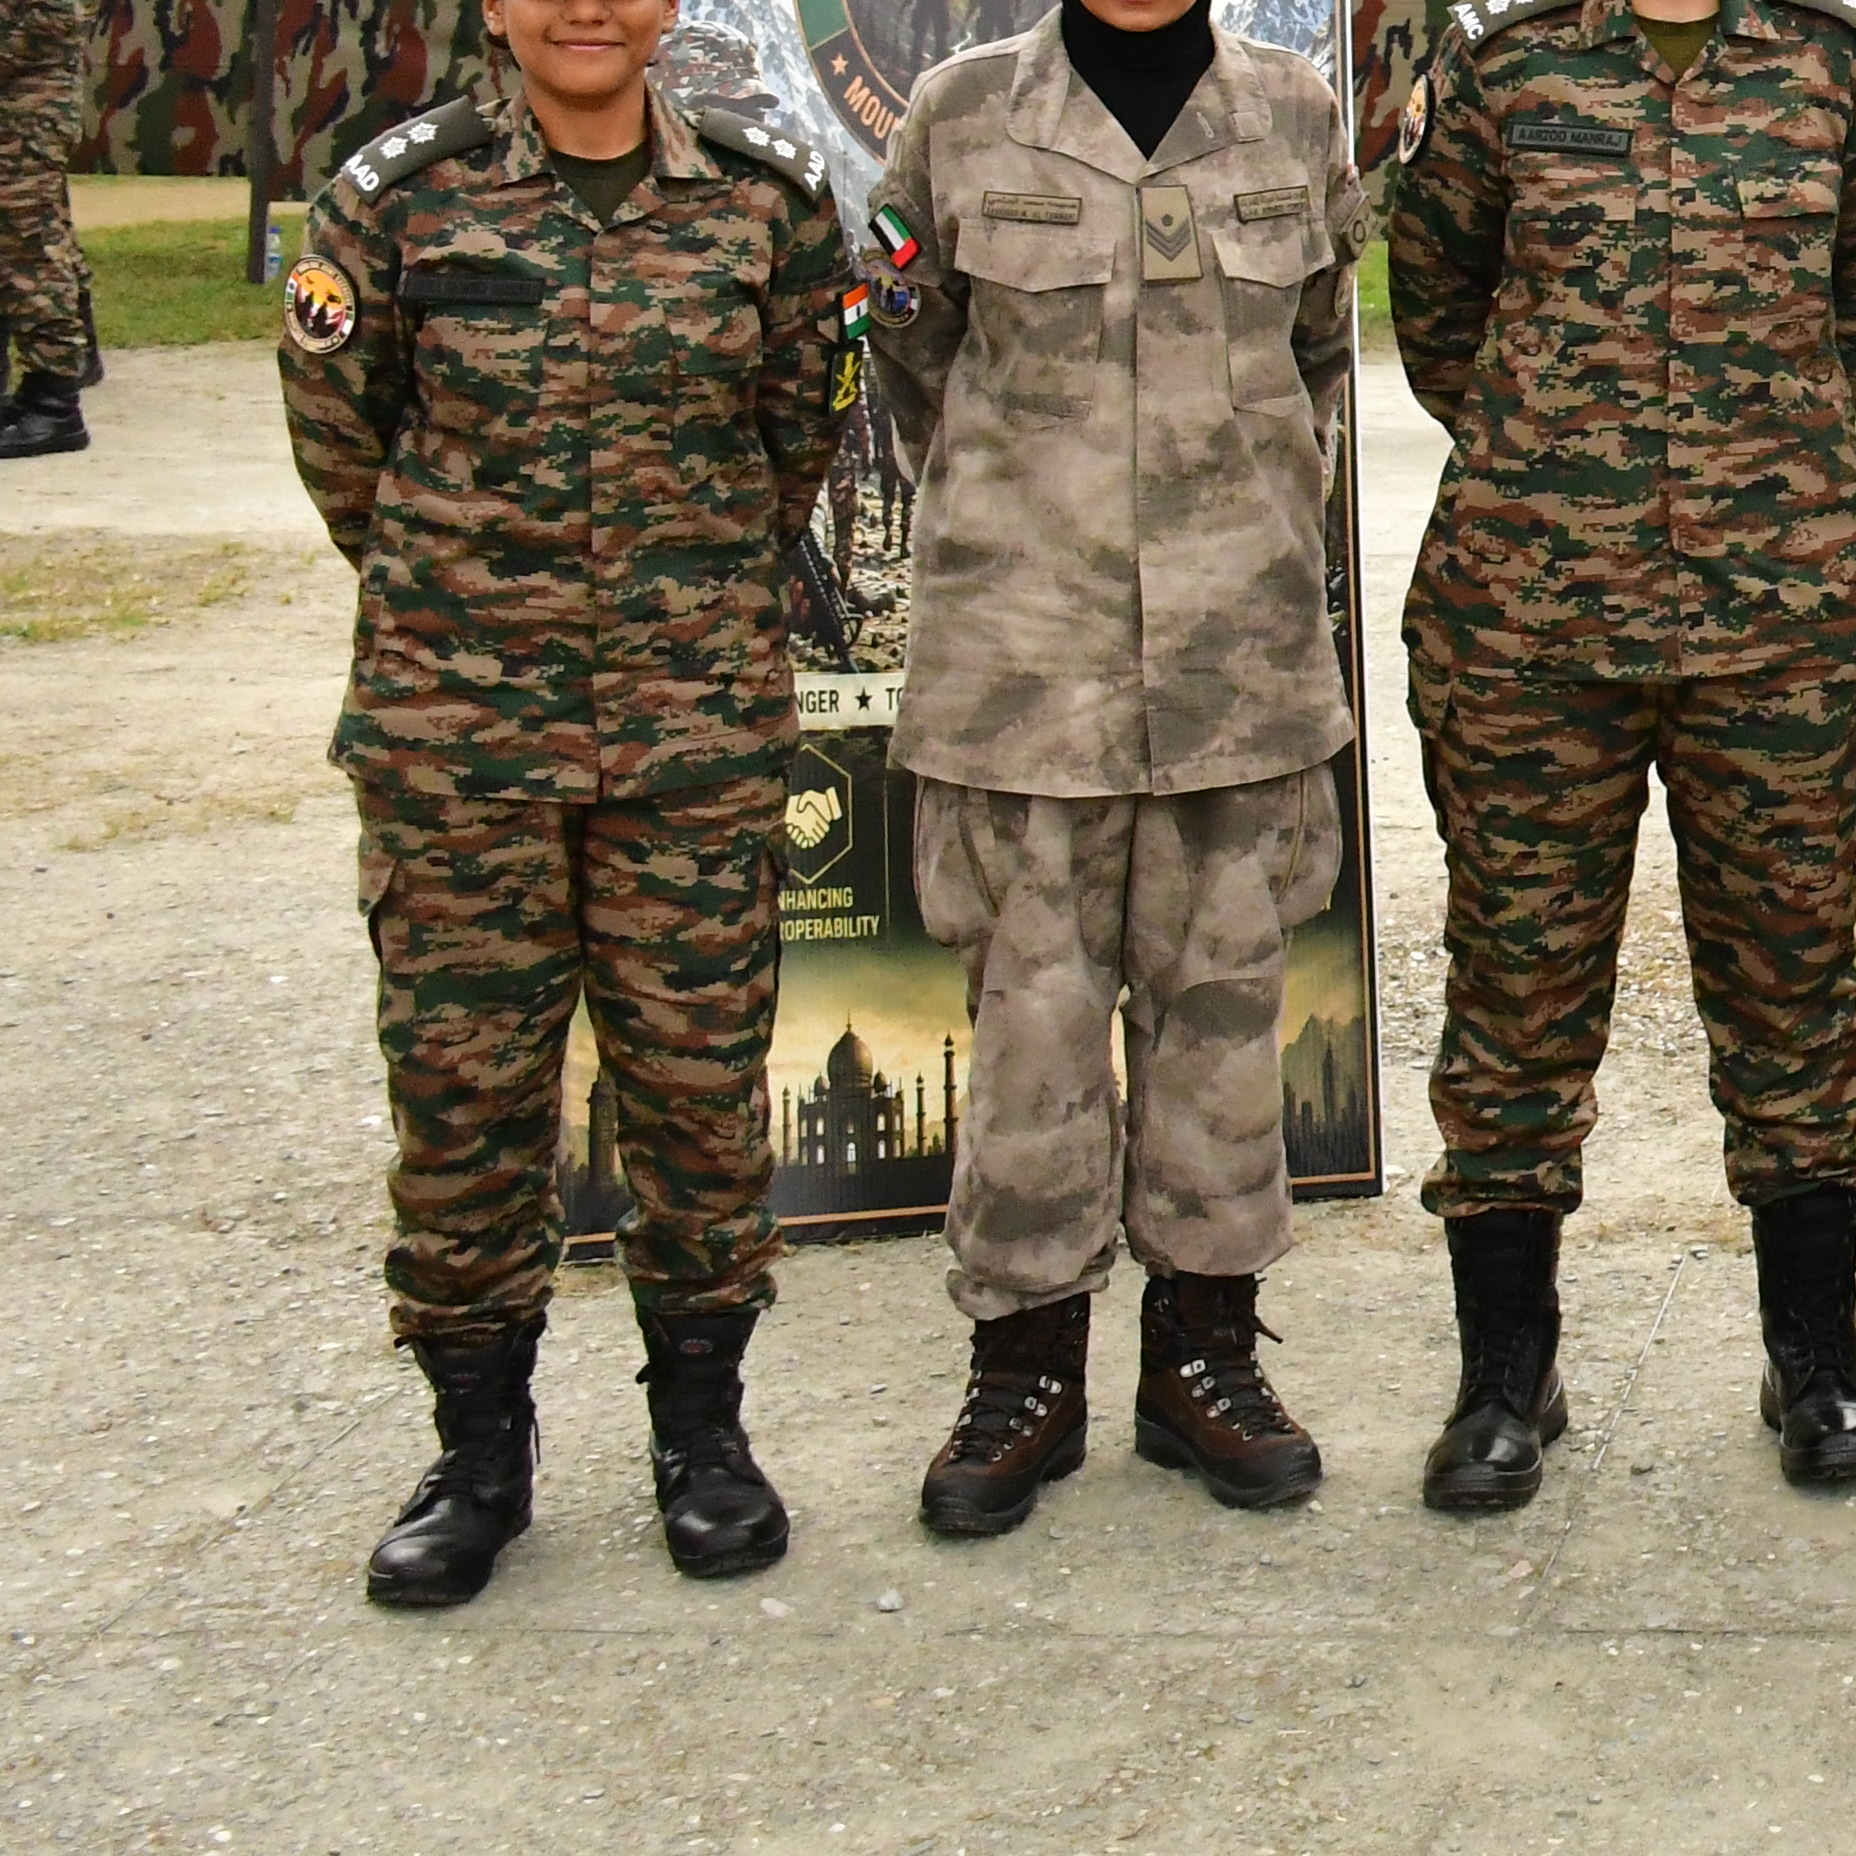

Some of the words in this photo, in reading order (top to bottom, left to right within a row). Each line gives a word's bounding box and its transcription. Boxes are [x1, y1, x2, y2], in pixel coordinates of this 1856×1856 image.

[1453, 3, 1484, 40] AMC
[843, 75, 899, 140] MOU
[345, 153, 380, 192] AAD
[804, 150, 825, 192] AAD
[777, 886, 854, 913] NHANCING
